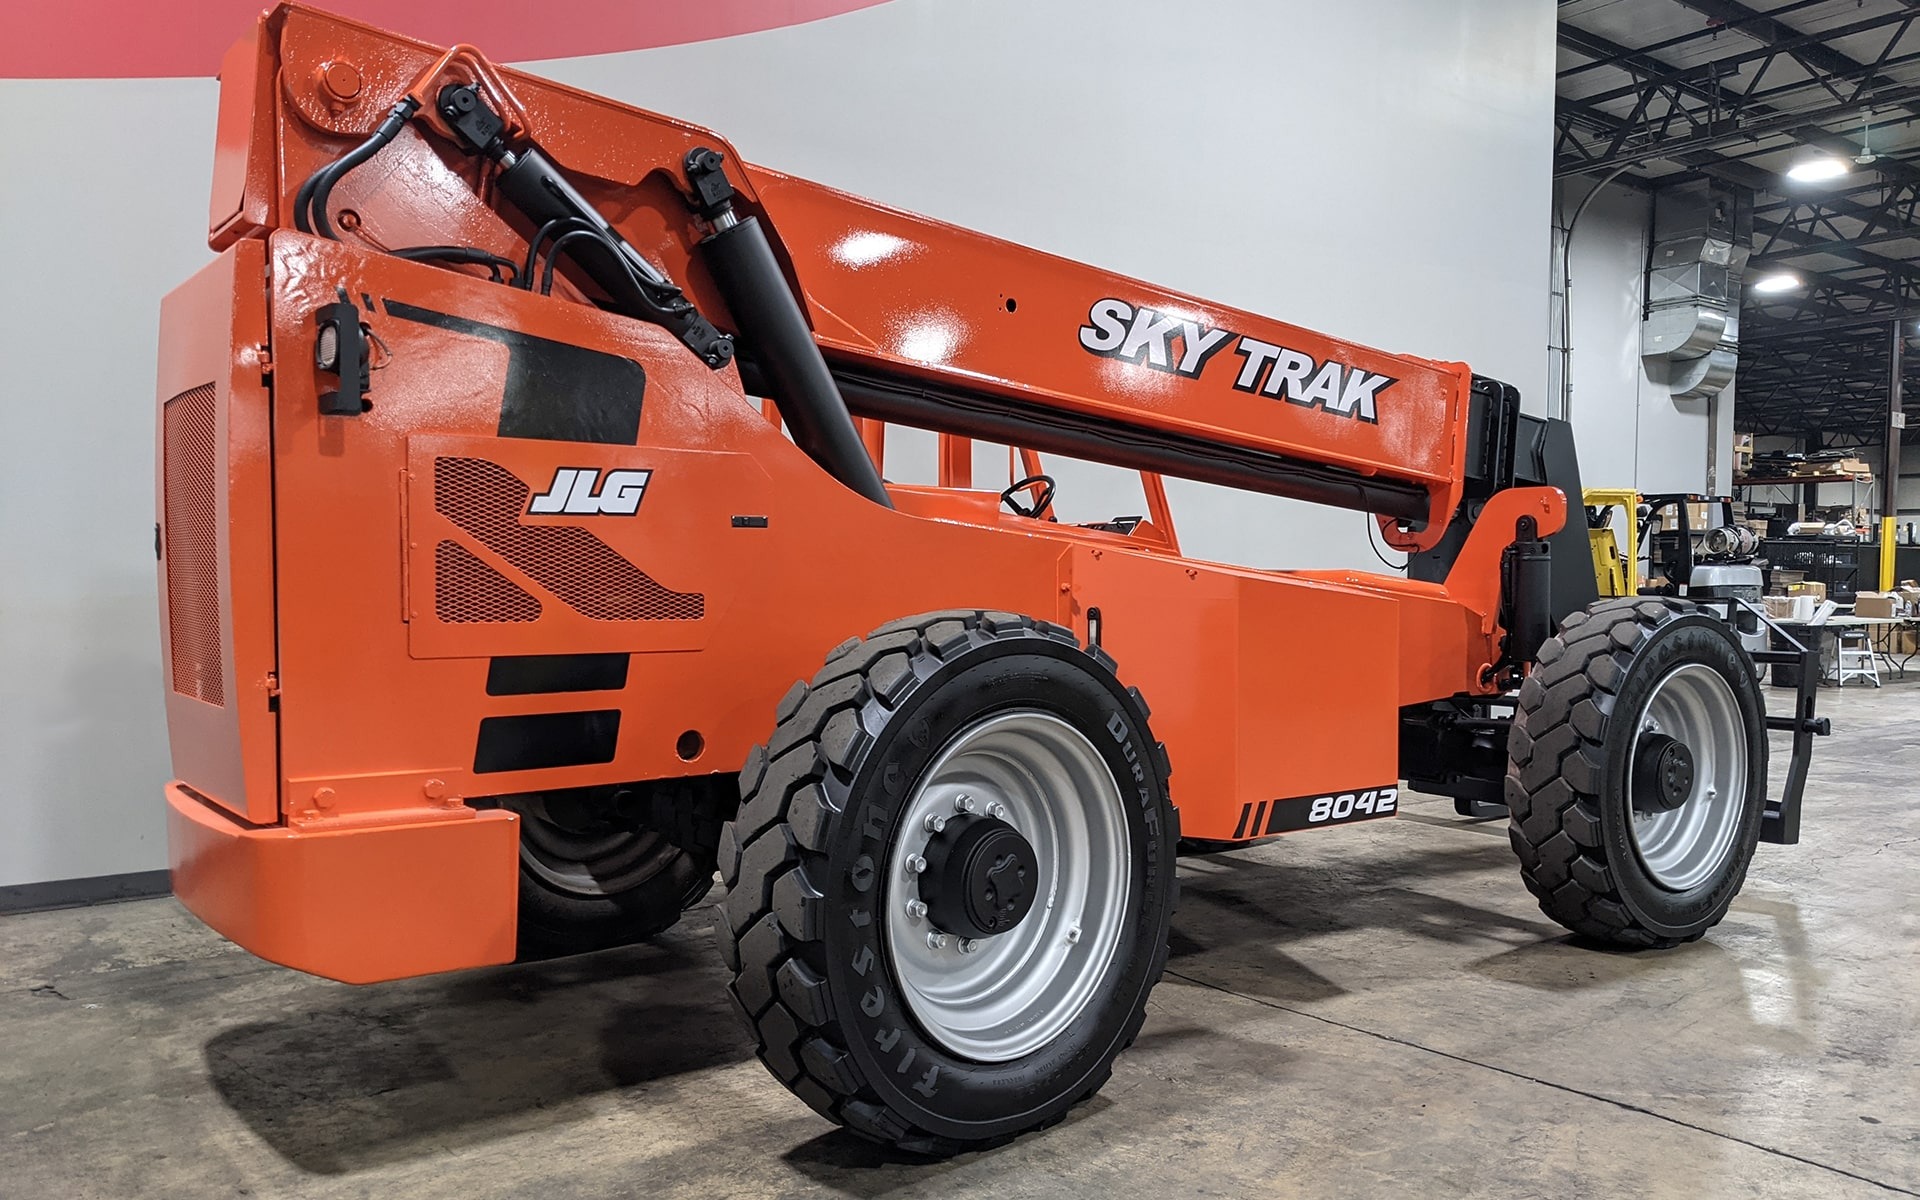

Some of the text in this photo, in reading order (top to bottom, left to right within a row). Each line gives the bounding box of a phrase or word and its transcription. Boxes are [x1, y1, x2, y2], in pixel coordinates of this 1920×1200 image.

[1079, 298, 1396, 422] SKY TRAK
[527, 467, 652, 516] JLG
[1308, 788, 1398, 823] 8042
[850, 761, 939, 1098] Firestone
